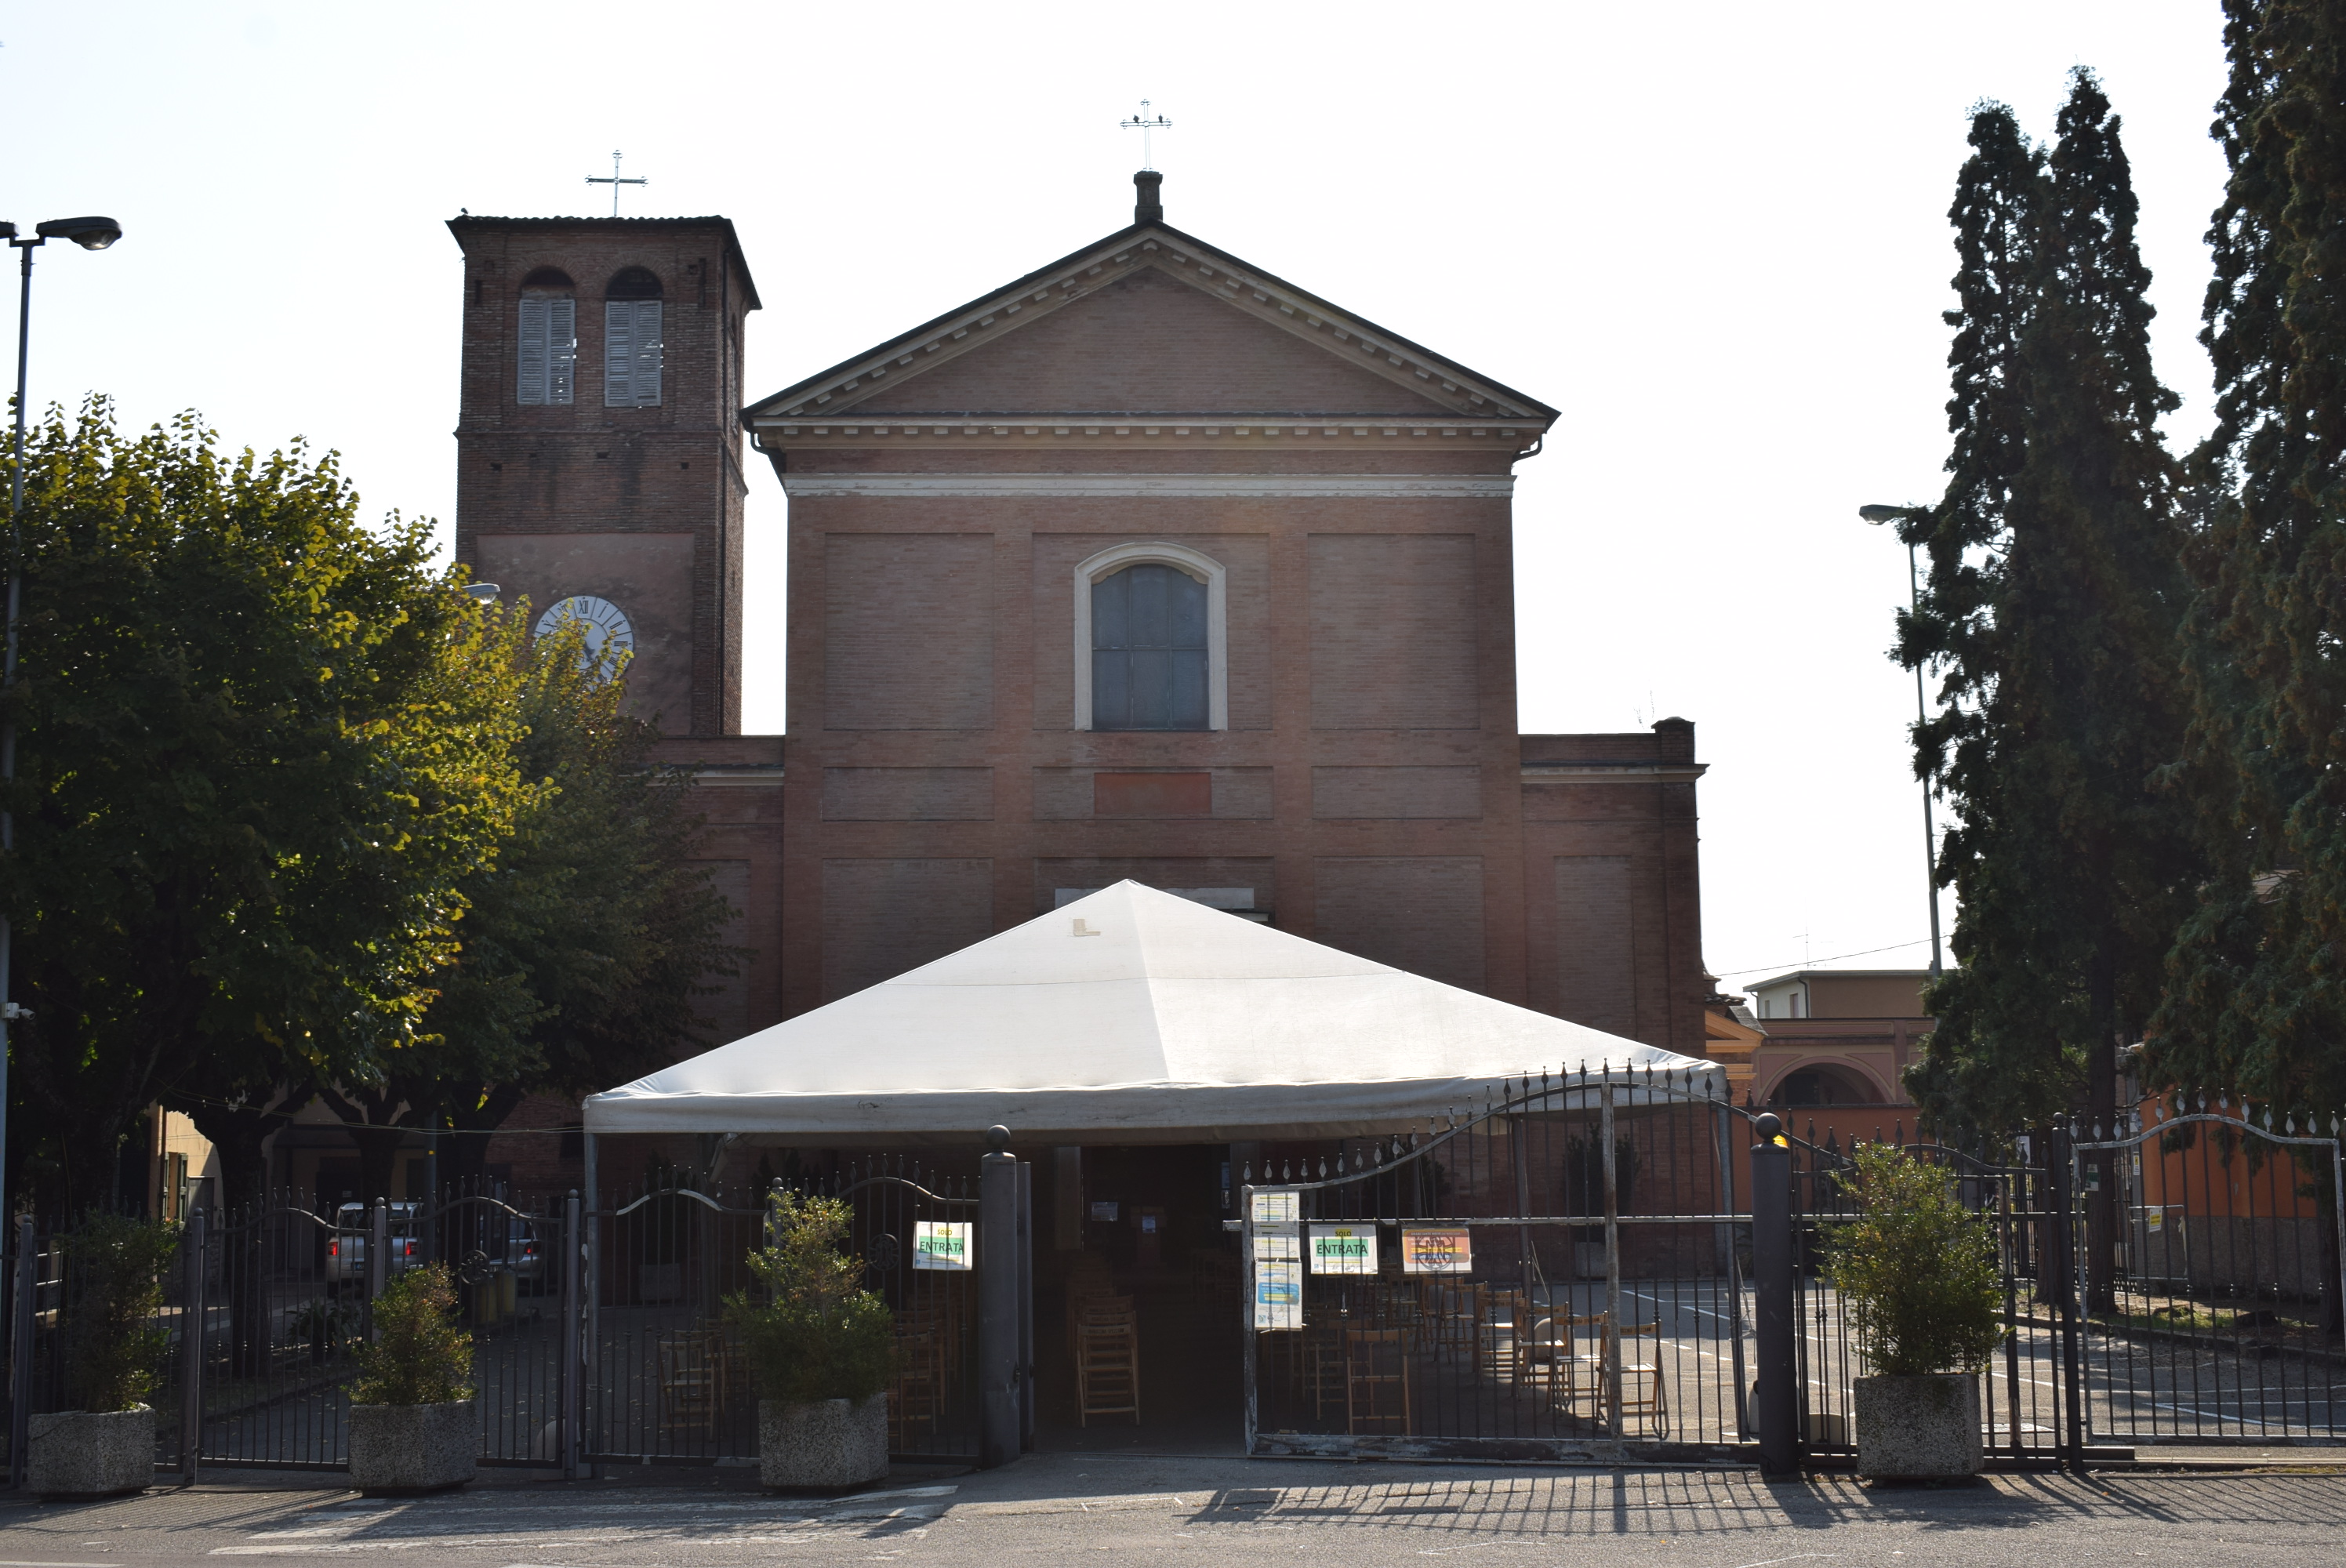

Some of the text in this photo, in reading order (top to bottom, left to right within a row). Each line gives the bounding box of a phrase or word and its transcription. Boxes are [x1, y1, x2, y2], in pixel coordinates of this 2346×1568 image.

[579, 600, 589, 614] XII
[920, 1241, 964, 1253] ENTRATA
[1317, 1244, 1368, 1254] ENTRATA
